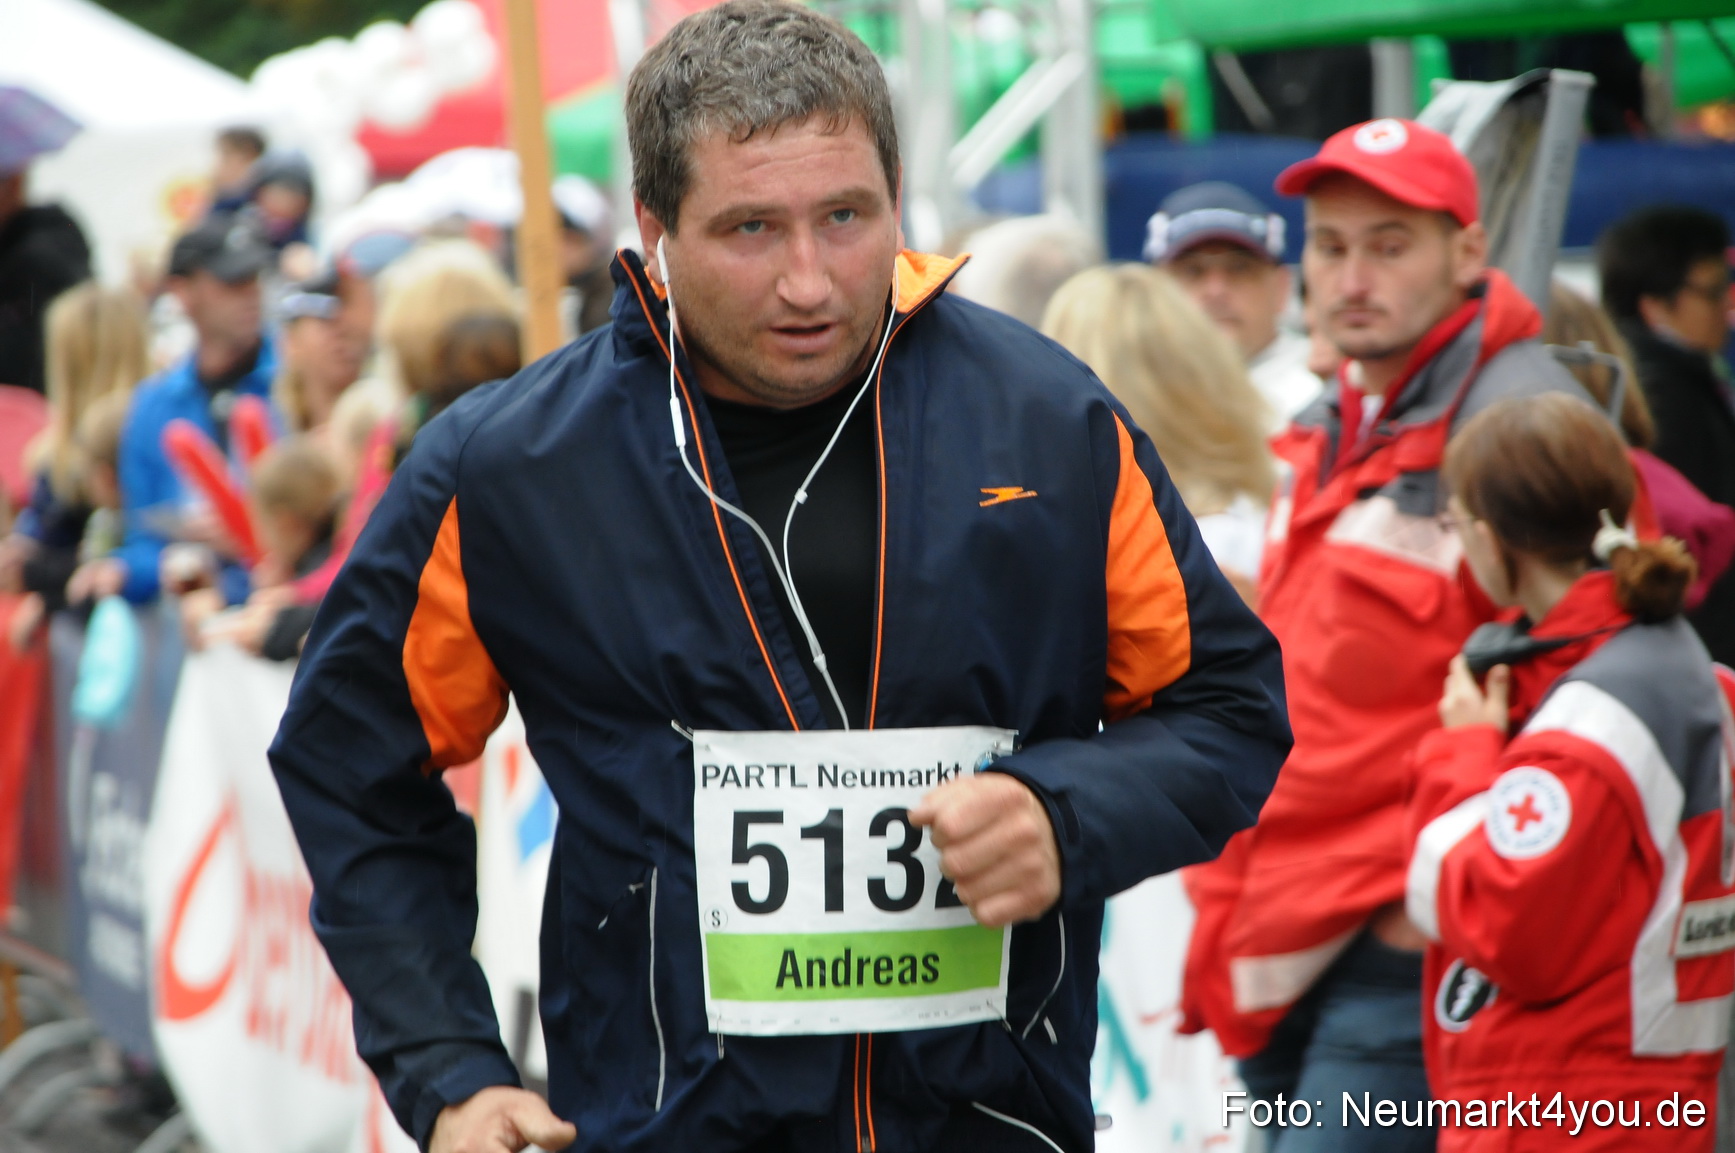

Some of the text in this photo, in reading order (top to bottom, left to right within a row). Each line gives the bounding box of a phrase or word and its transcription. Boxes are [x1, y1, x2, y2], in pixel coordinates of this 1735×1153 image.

[702, 761, 963, 789] PARTL Neumarkt
[730, 806, 969, 915] 513
[775, 948, 940, 989] Andreas
